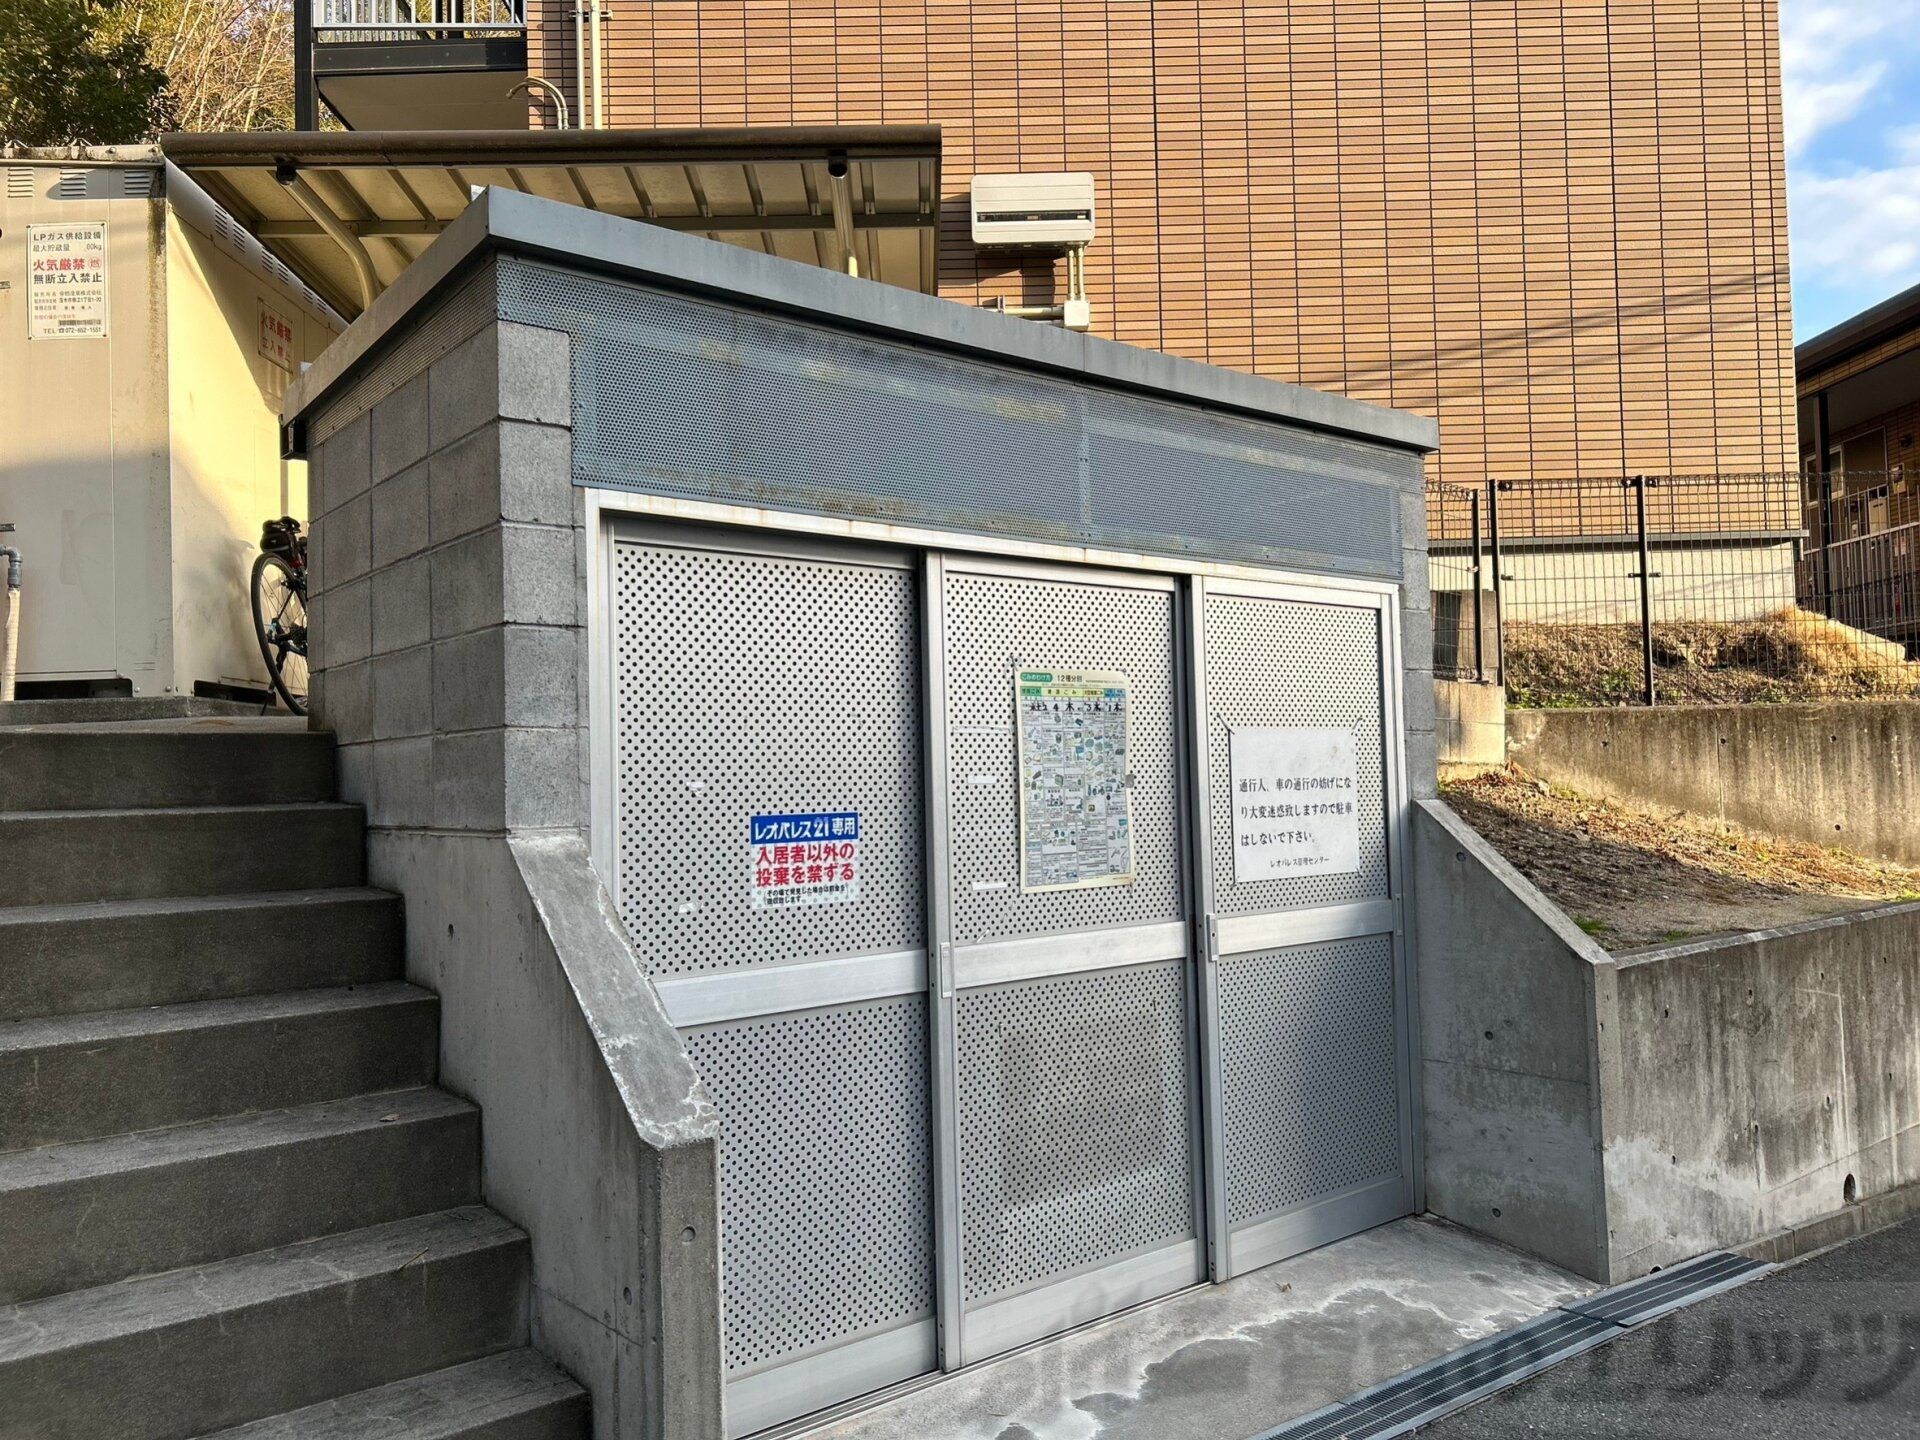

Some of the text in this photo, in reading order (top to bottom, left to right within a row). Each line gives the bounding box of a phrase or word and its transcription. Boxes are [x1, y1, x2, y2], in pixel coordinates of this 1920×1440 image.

[33, 231, 102, 241] LPガス供給設備
[33, 258, 85, 271] 火気厳禁
[33, 272, 102, 284] 無断立入禁止
[260, 310, 292, 343] 火気厳禁
[1241, 802, 1353, 819] り大変迷惑致しますので駐車
[755, 817, 855, 840] レオパレス21専用
[1241, 830, 1316, 847] はしないで下さい。
[756, 843, 855, 865] 入居者以外の
[756, 863, 854, 887] 投棄を禁ずる
